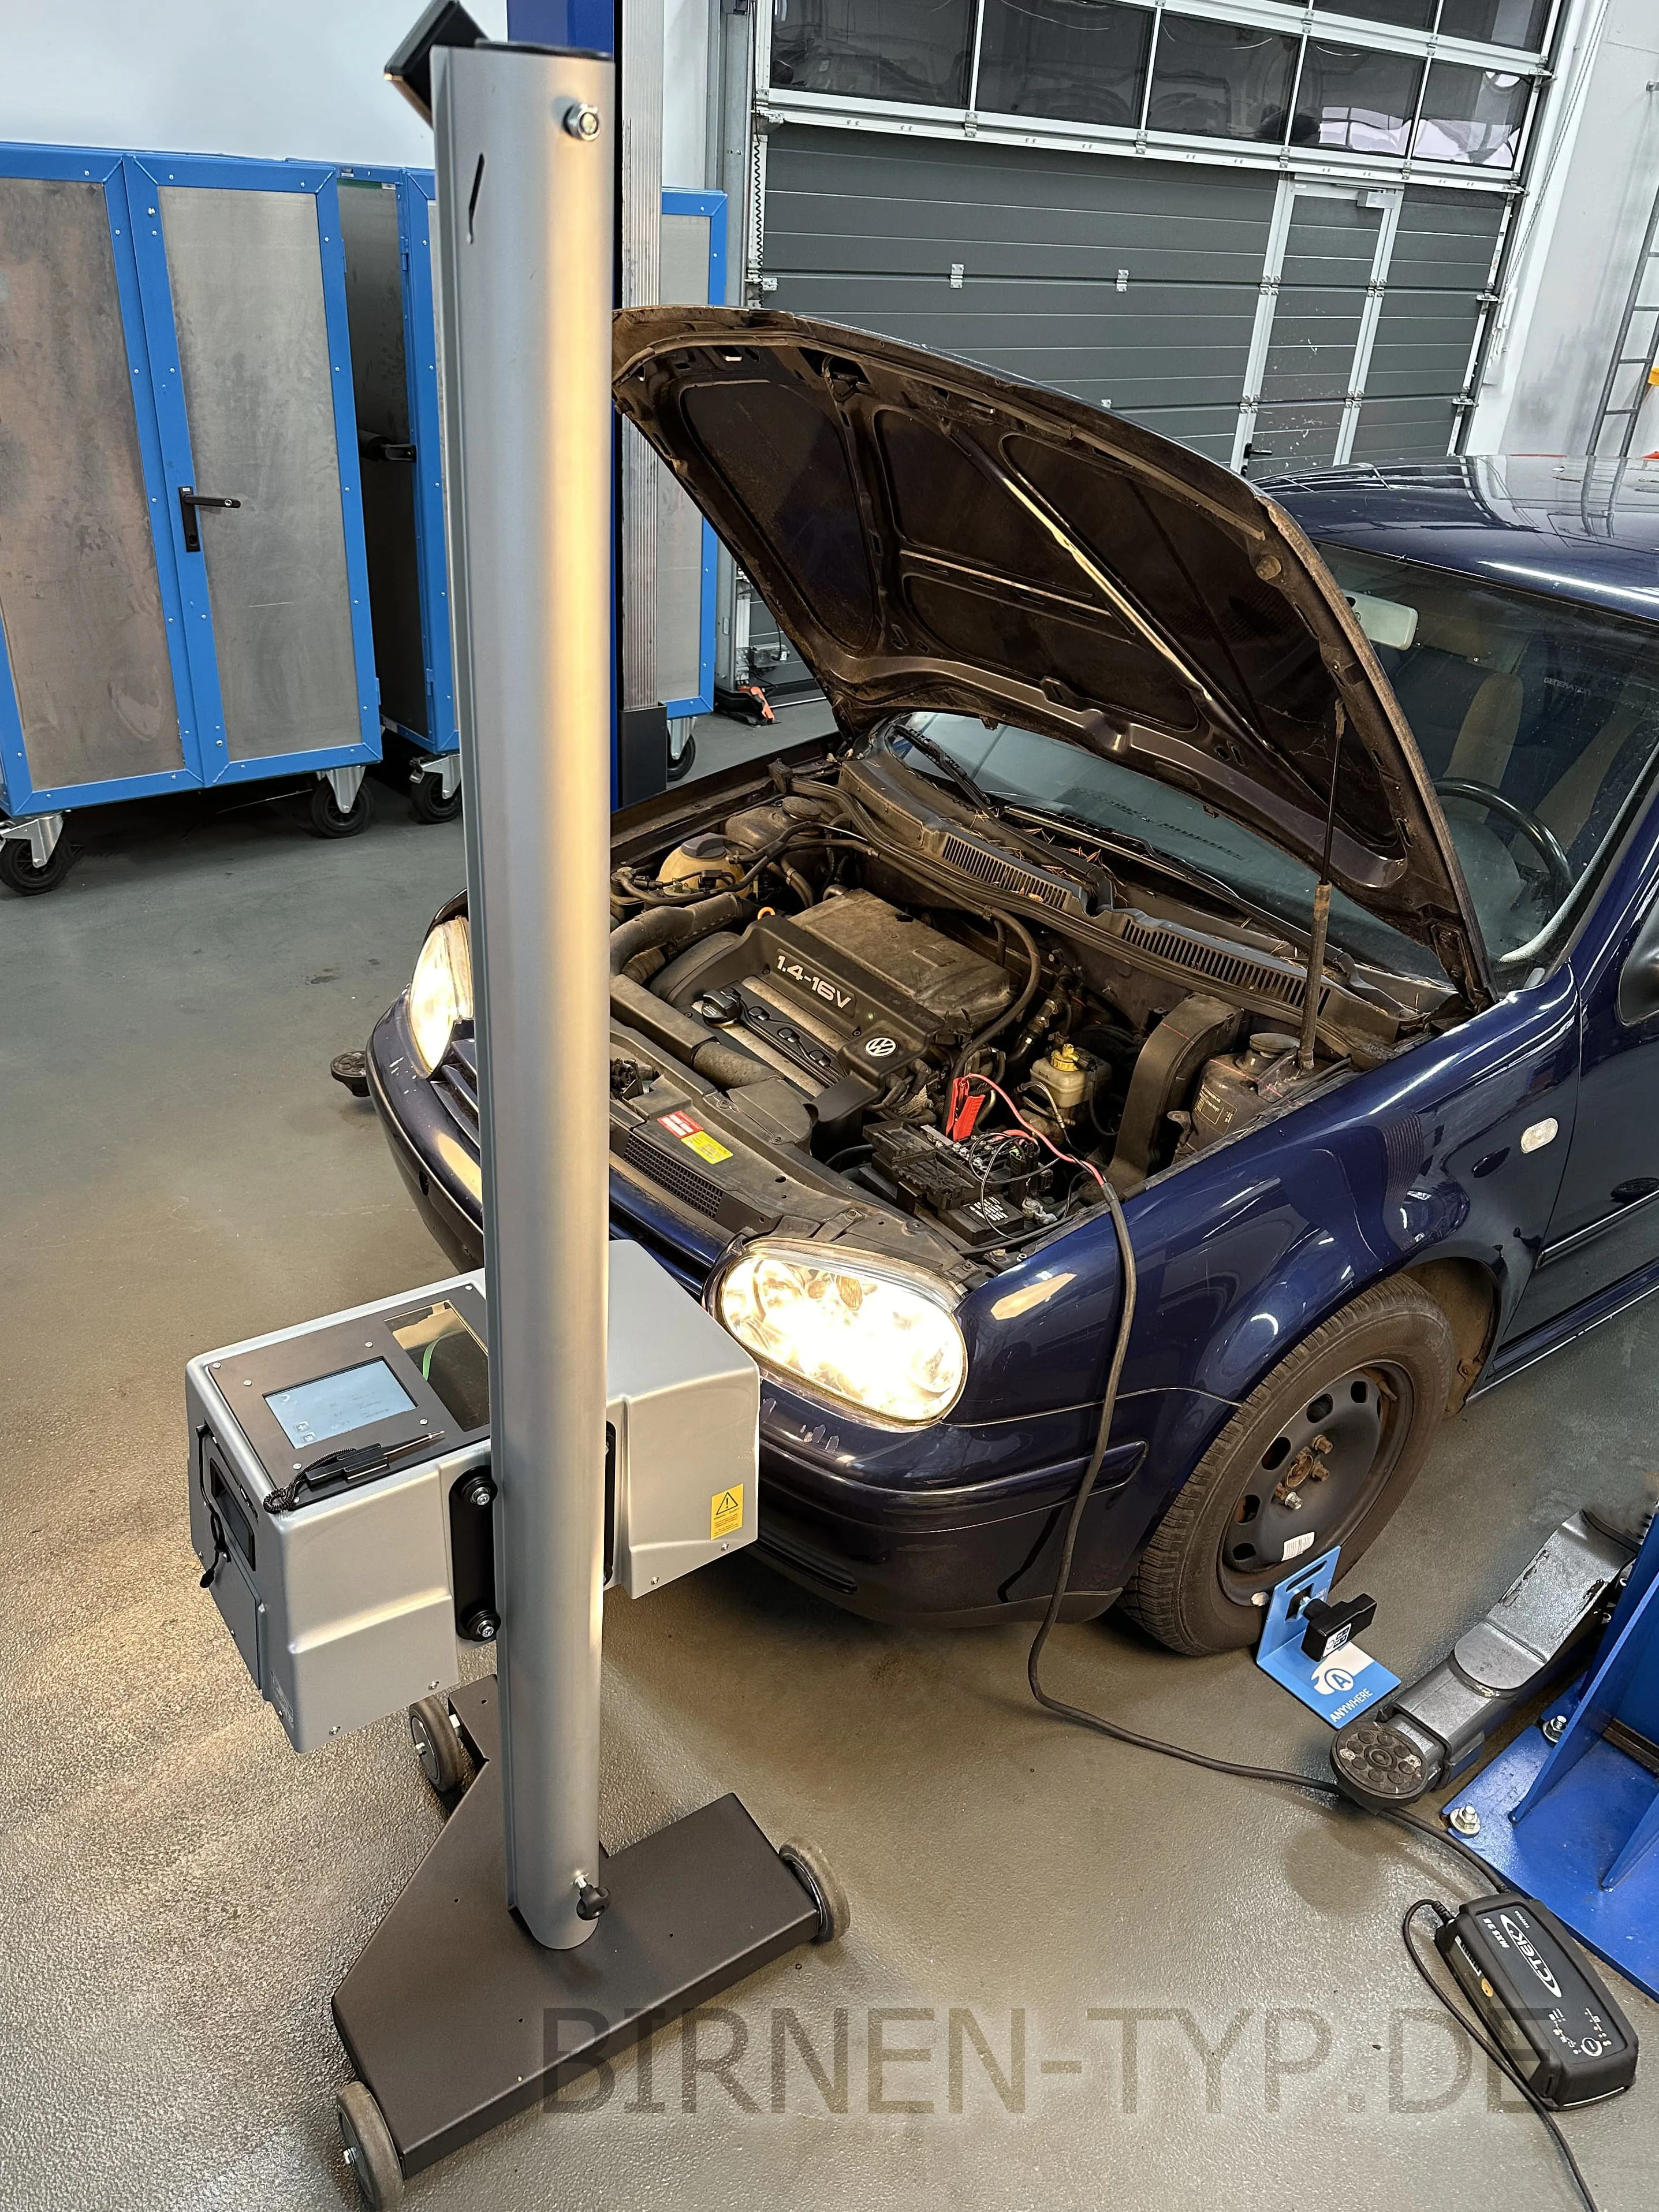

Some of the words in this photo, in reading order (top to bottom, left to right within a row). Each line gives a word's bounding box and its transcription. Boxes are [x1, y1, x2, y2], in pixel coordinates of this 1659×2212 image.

[777, 955, 852, 1008] 1.4-16V
[1331, 1674, 1352, 1689] A
[1329, 1688, 1373, 1722] ANYWHERE
[1509, 1932, 1553, 1982] CTEK
